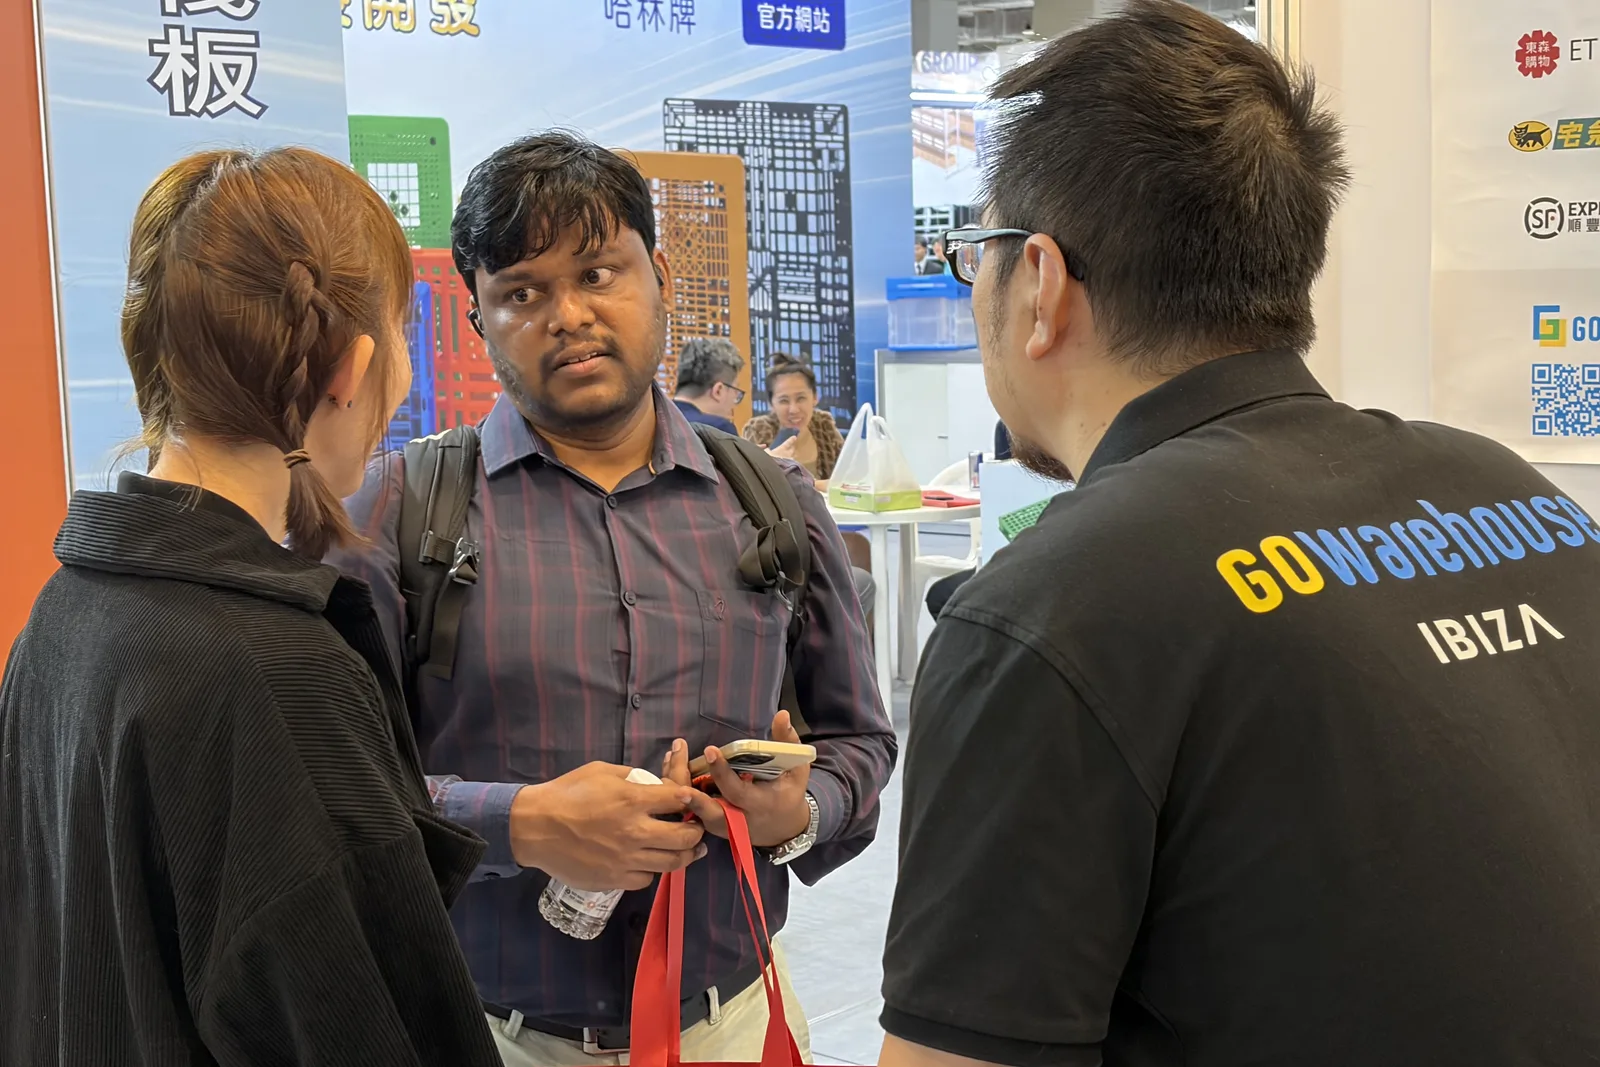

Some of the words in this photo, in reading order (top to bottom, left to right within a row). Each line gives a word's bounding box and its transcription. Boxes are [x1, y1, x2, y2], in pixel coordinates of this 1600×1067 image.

[757, 2, 831, 33] 官方網站
[1525, 40, 1550, 54] 東森
[1570, 37, 1599, 61] ET
[147, 0, 269, 119] 板
[921, 51, 979, 74] GROUP
[1568, 201, 1600, 217] EXP
[1572, 316, 1600, 342] GO
